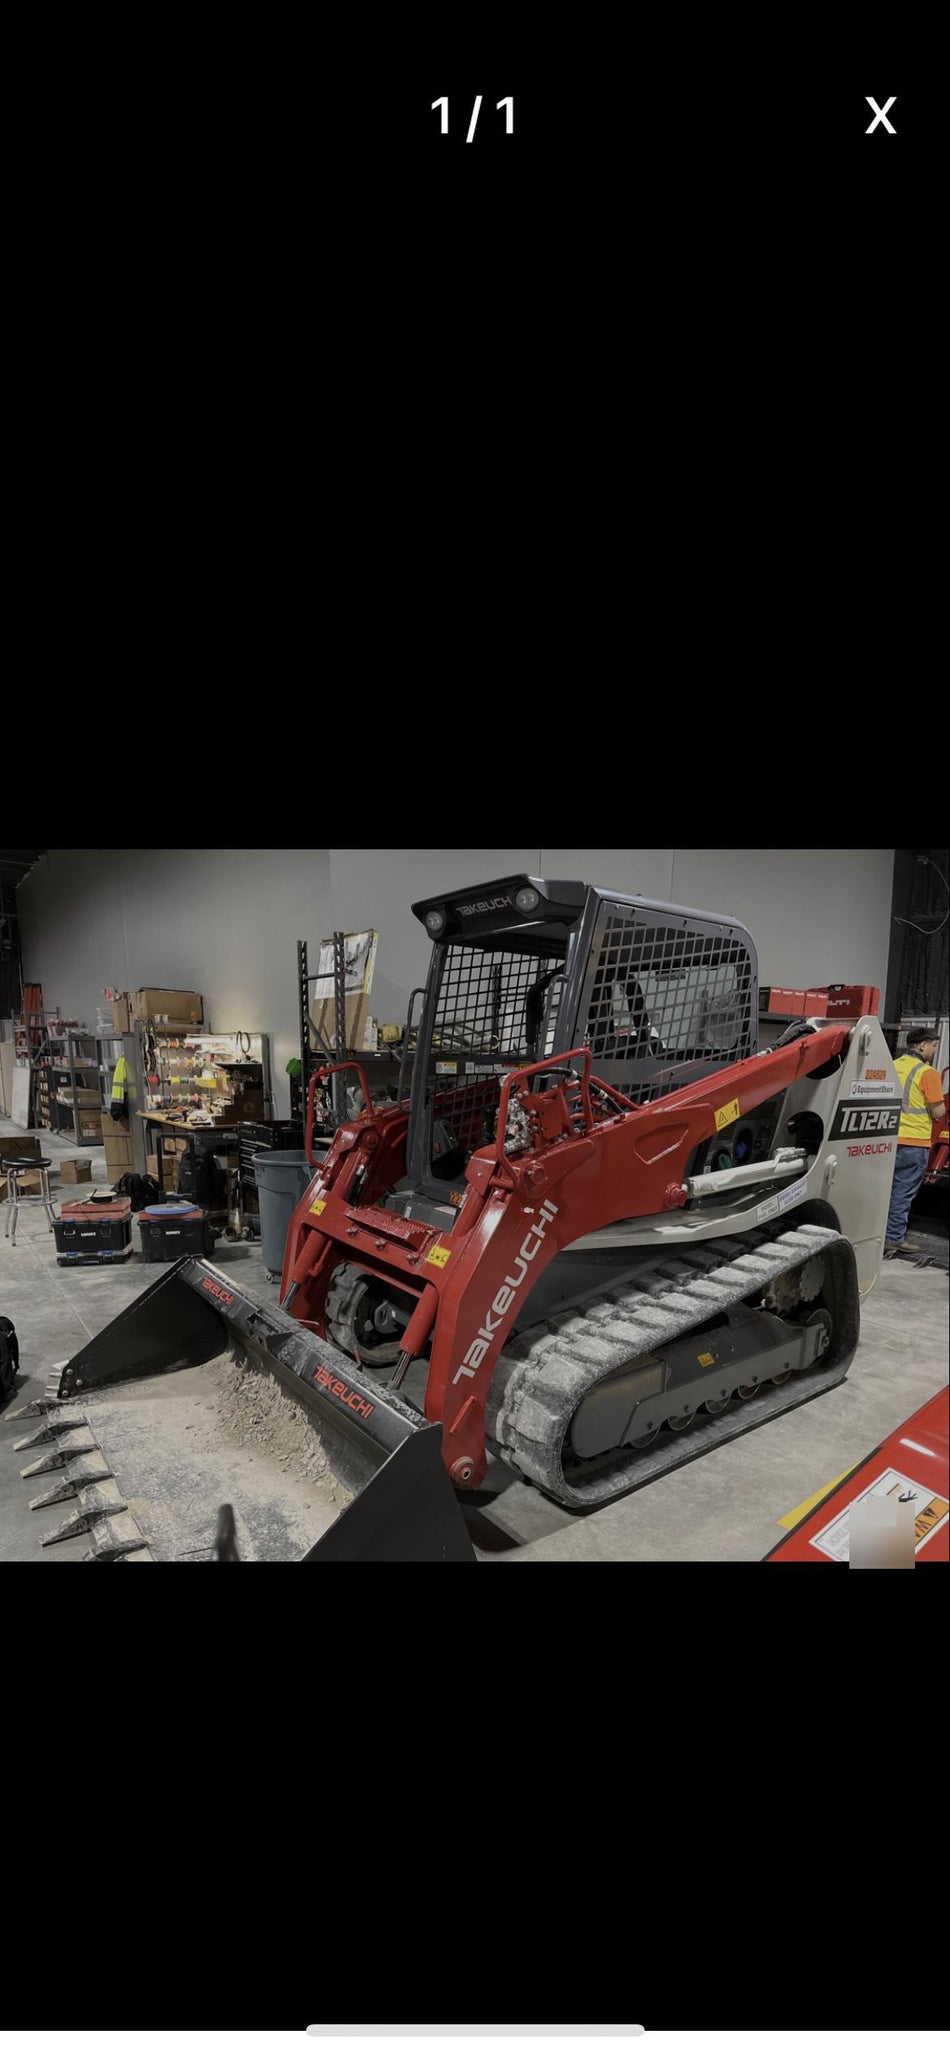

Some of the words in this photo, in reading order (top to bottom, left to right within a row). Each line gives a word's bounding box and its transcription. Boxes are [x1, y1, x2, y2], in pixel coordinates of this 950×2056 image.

[456, 896, 512, 917] TAKEUCH
[840, 1105, 900, 1133] TL12R2
[846, 1143, 893, 1157] TAKEUCHI
[202, 1277, 234, 1306] TAKEUCHI
[452, 1199, 559, 1385] TAKEUCHI
[312, 1363, 375, 1420] TAKEUCHI
